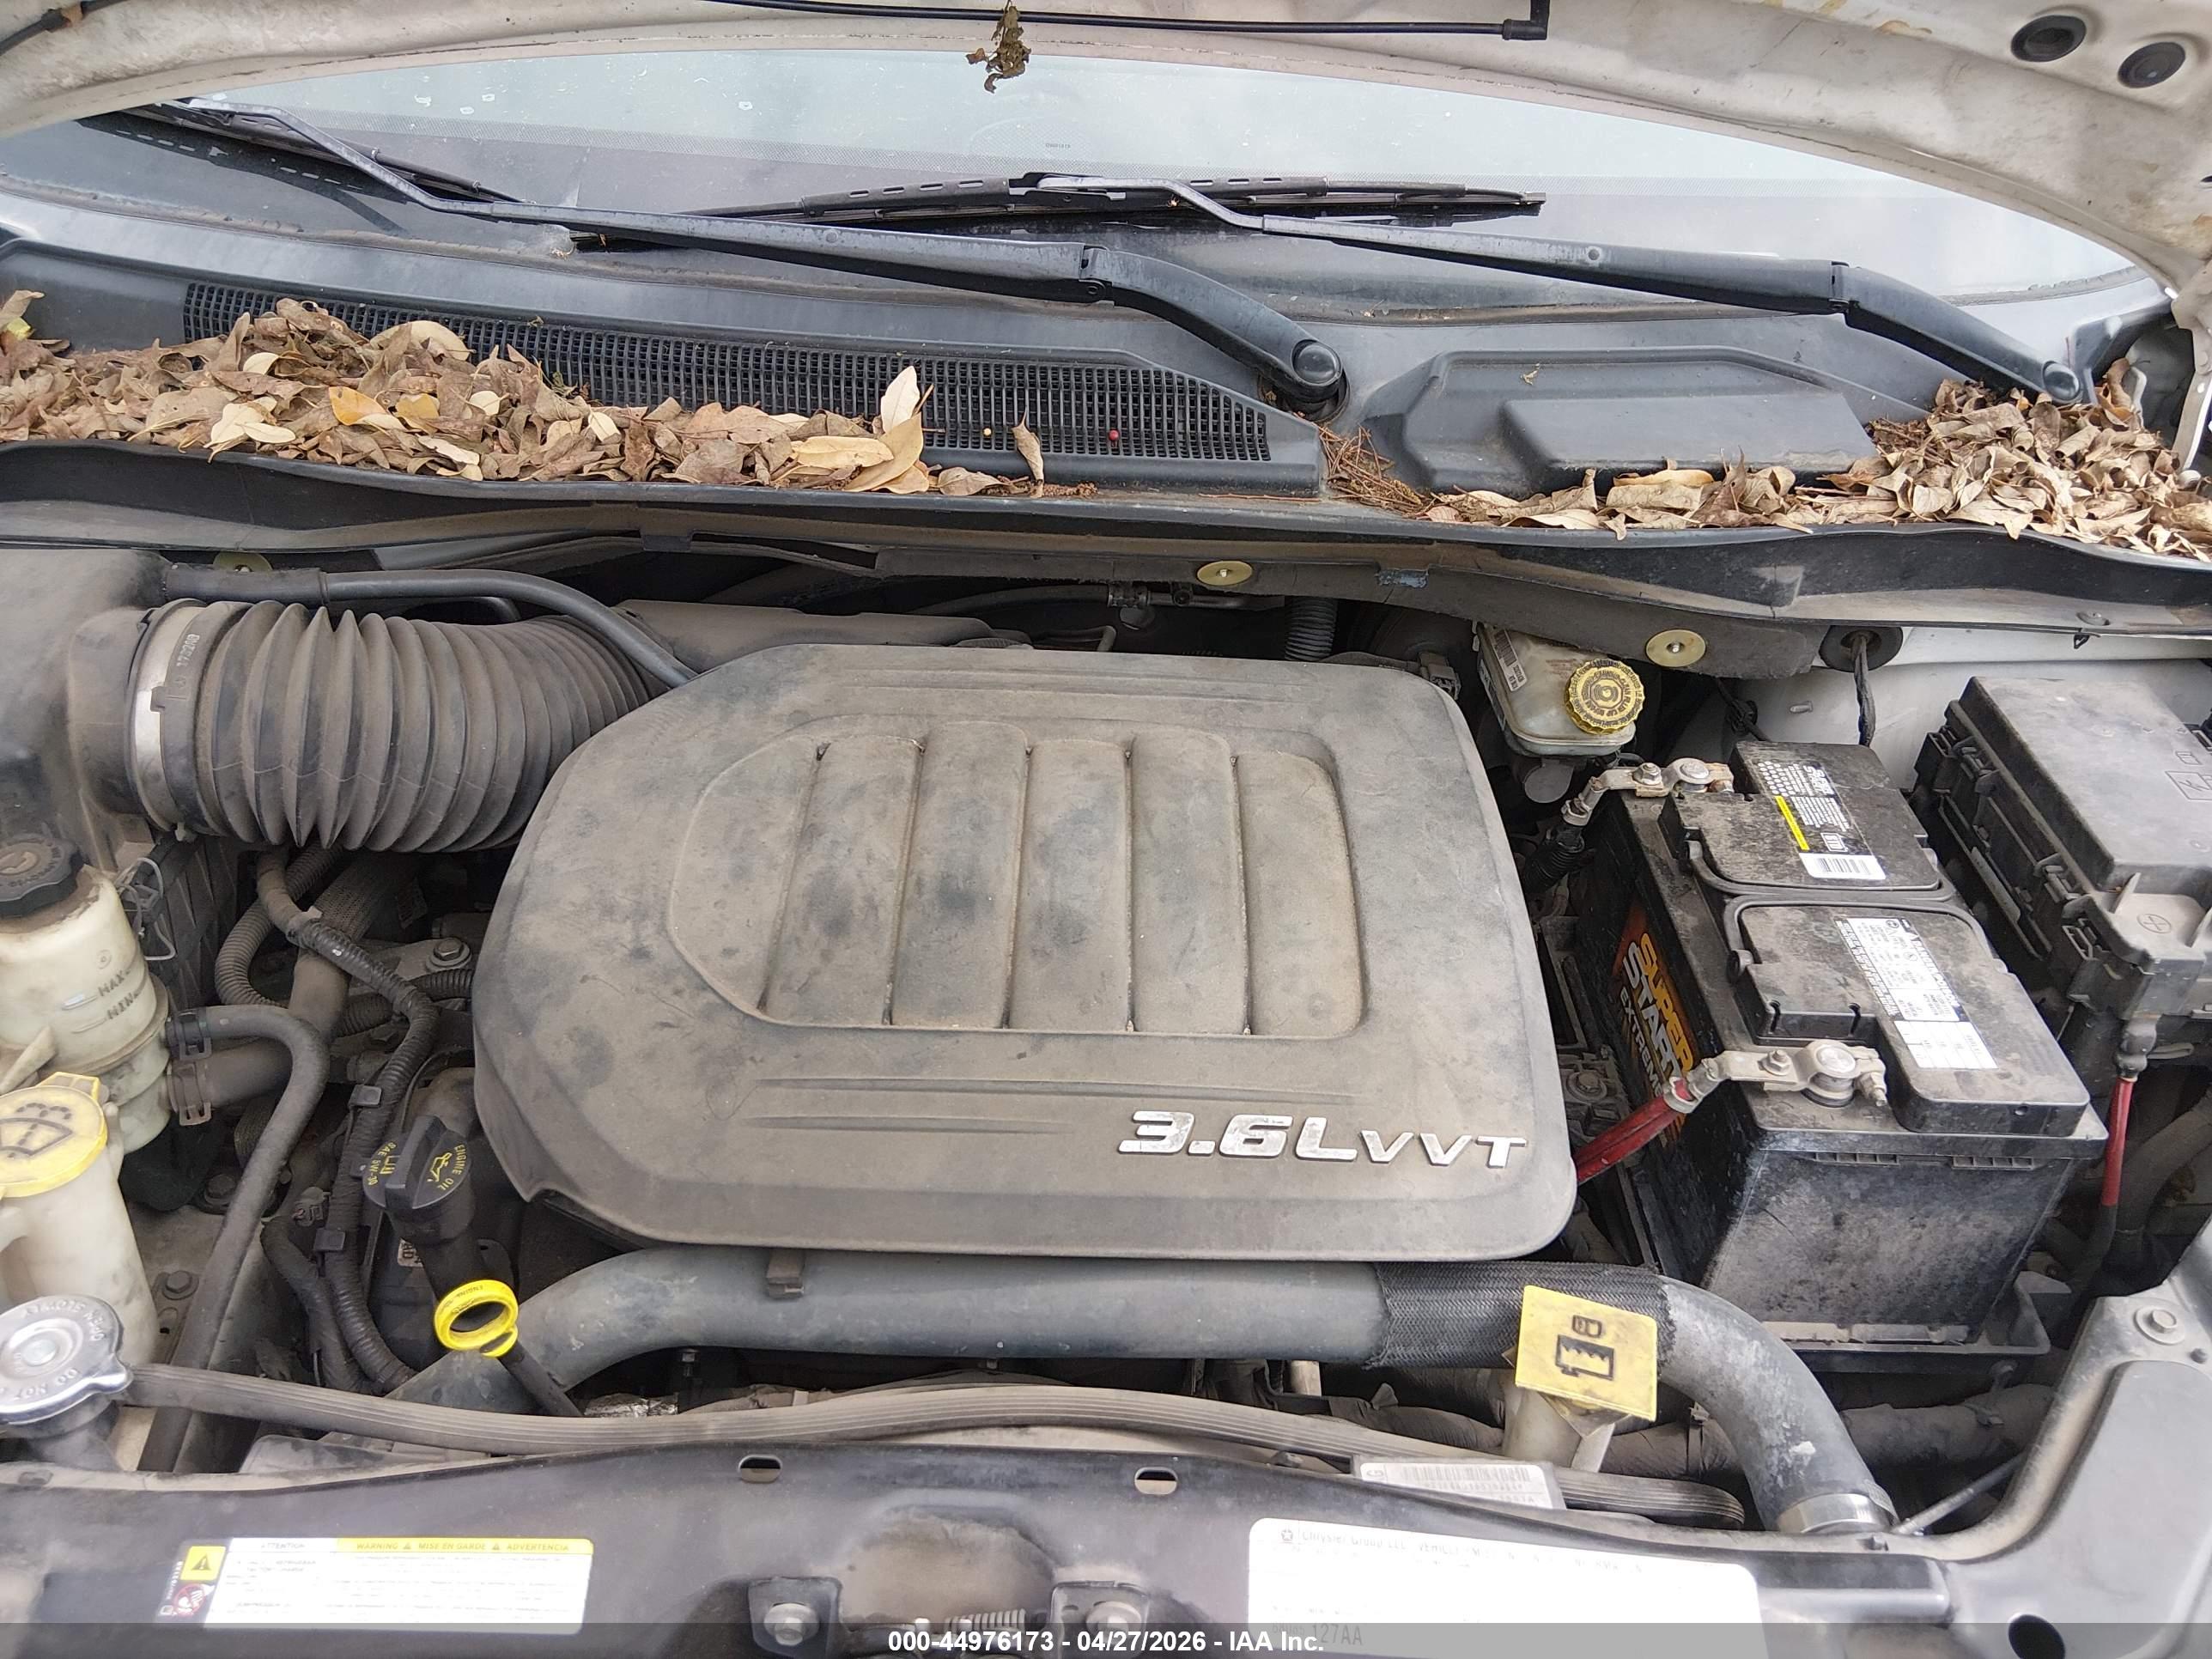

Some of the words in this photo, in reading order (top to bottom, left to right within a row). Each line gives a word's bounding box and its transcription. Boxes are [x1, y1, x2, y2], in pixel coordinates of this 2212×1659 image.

[98, 969, 125, 997] MAX
[107, 991, 134, 1020] MIN
[1623, 942, 1684, 1081] START
[1640, 933, 1693, 1073] SUPER
[378, 1142, 397, 1157] SAE
[1118, 1110, 1358, 1162] 3.6L
[1361, 1130, 1528, 1169] VVT
[367, 1159, 381, 1186] 5W-30
[453, 1144, 467, 1176] ENGINE
[437, 1177, 455, 1192] OIL
